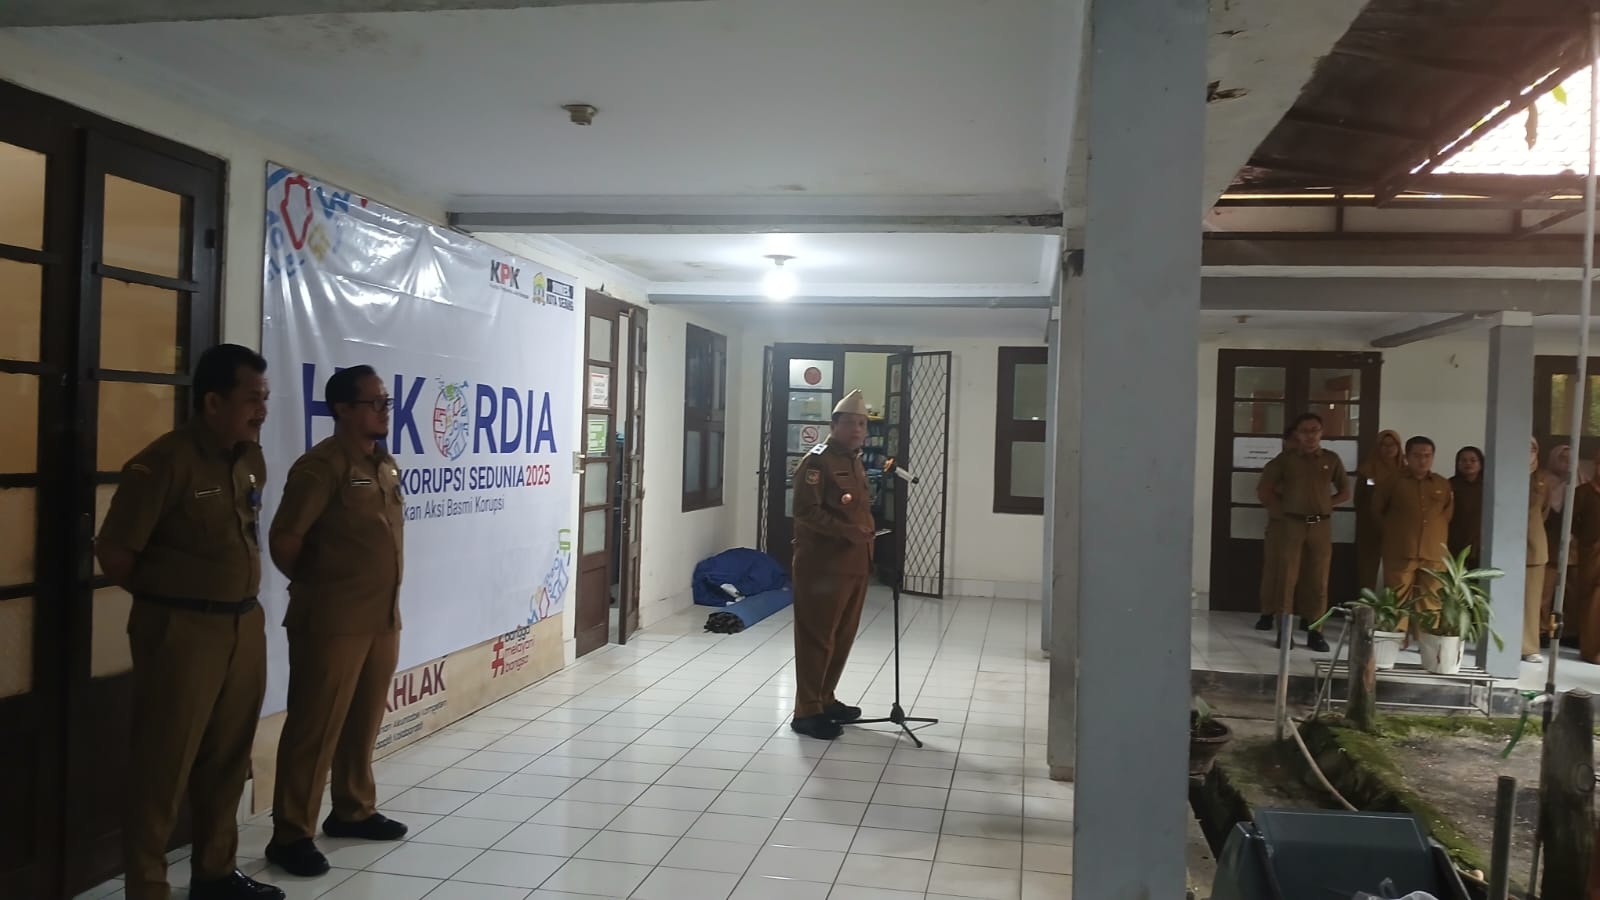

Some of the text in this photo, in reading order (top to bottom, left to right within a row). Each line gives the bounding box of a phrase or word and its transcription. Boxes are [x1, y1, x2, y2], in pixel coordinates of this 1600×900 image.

[490, 260, 520, 289] KPK
[526, 465, 550, 486] 2025
[424, 499, 445, 519] Aksi
[447, 496, 473, 517] Basmi
[475, 494, 505, 515] Korupsi
